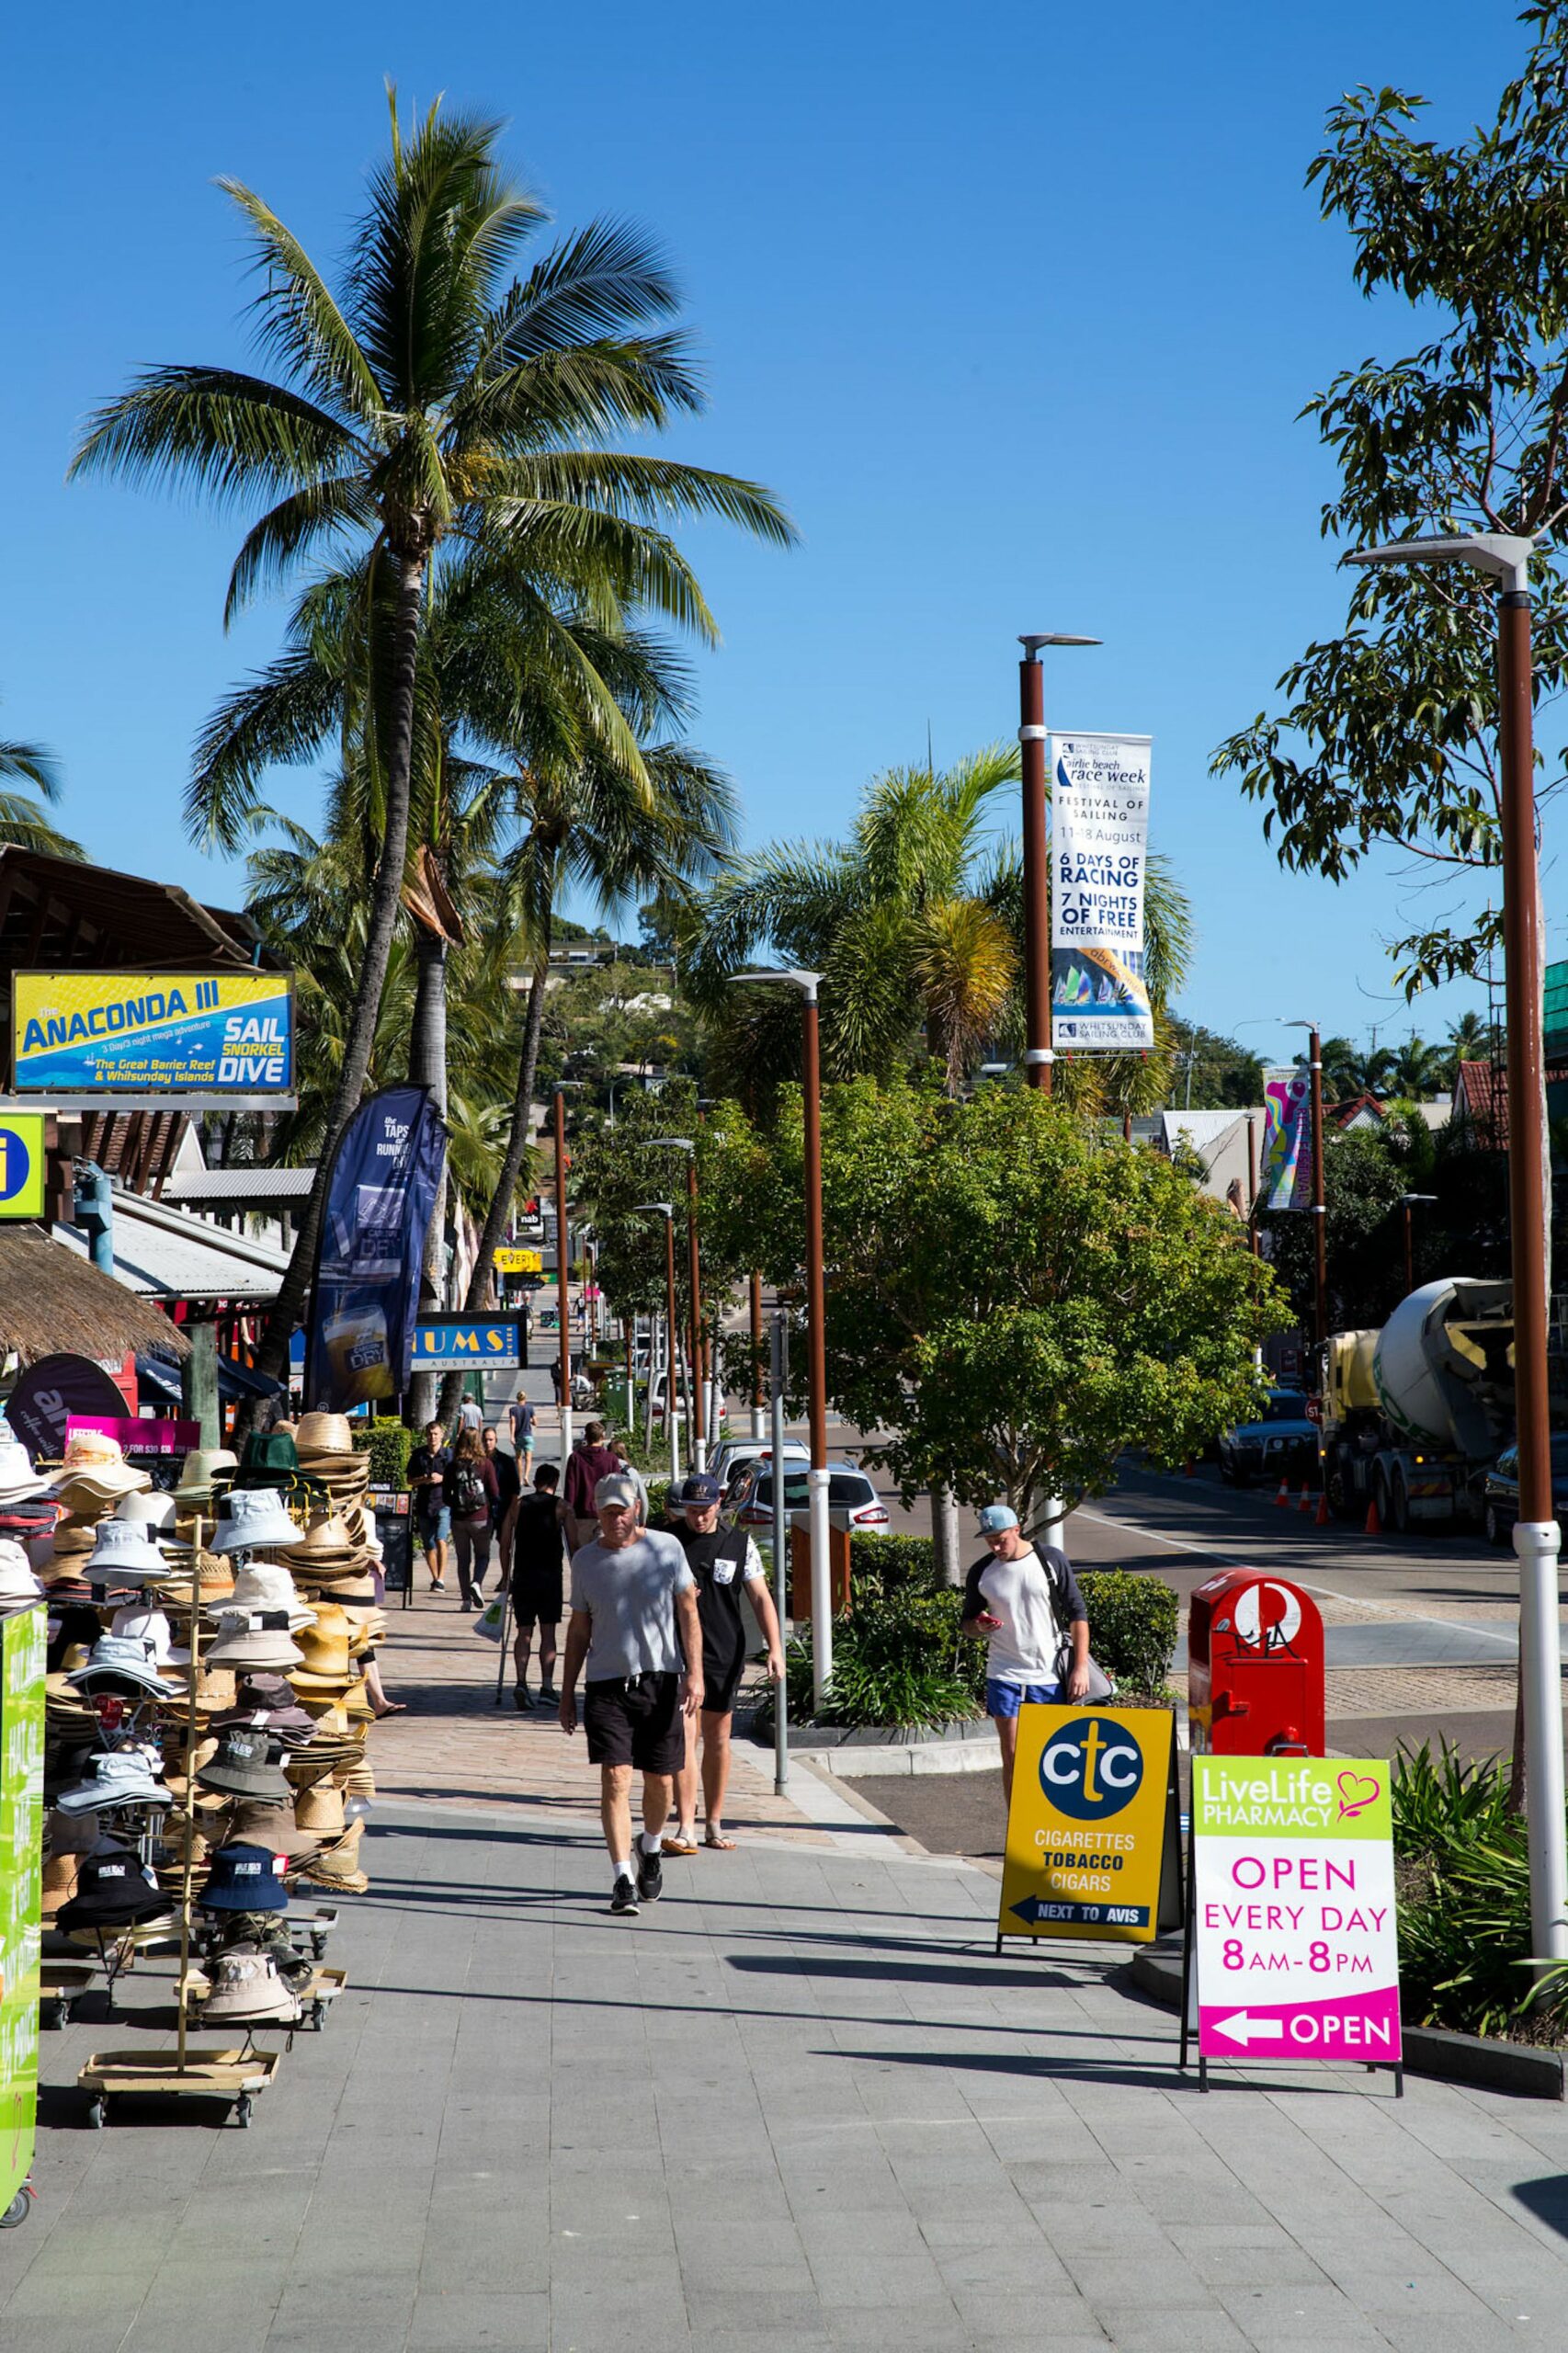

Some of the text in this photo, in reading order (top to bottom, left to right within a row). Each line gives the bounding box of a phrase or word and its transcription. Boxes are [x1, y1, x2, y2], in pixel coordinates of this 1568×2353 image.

[1092, 759, 1119, 770] beach
[1071, 768, 1146, 783] race week
[1059, 796, 1143, 810] FESTIVAL OF
[1074, 810, 1129, 821] SAILING
[1096, 829, 1142, 845] August
[1060, 852, 1140, 870] 6 DAYS OF
[1061, 867, 1139, 888] RACING
[1062, 892, 1137, 910] 7 NIGHTS
[1062, 908, 1136, 927] OF FREE
[1060, 926, 1138, 939] ENTERTAINMENT
[22, 980, 220, 1052] ANACONDA III
[153, 1030, 175, 1043] mega
[175, 1020, 211, 1039] adventure
[223, 1017, 285, 1043] SAIL
[1079, 1030, 1146, 1039] SAILING CLUB
[222, 1043, 286, 1056] SNORKEL
[96, 1059, 216, 1070] The Great Barrier Reef
[218, 1058, 284, 1083] DIVE
[95, 1071, 215, 1085] & Whitsunday Islands
[384, 1116, 397, 1124] the
[384, 1124, 410, 1139] TAPS
[1297, 1138, 1310, 1199] FESTIVAL
[520, 1214, 539, 1223] nab
[412, 1330, 504, 1354] UMS
[431, 1358, 516, 1368] AUSTRALIA
[130, 1444, 143, 1453] FOR
[1042, 1720, 1139, 1802] ctc
[1202, 1768, 1333, 1804] LiveLife
[1203, 1804, 1333, 1827] PHARMACY
[1034, 1830, 1135, 1851] CIGARETTES
[1043, 1852, 1123, 1870] TOBACCO
[1051, 1872, 1111, 1892] CIGARS
[1232, 1857, 1356, 1891] OPEN
[1038, 1904, 1139, 1923] NEXT TO AVIS
[1206, 1904, 1388, 1932] EVERY DAY
[1222, 1939, 1373, 1973] 8AM-8PM
[1290, 2014, 1391, 2045] OPEN
